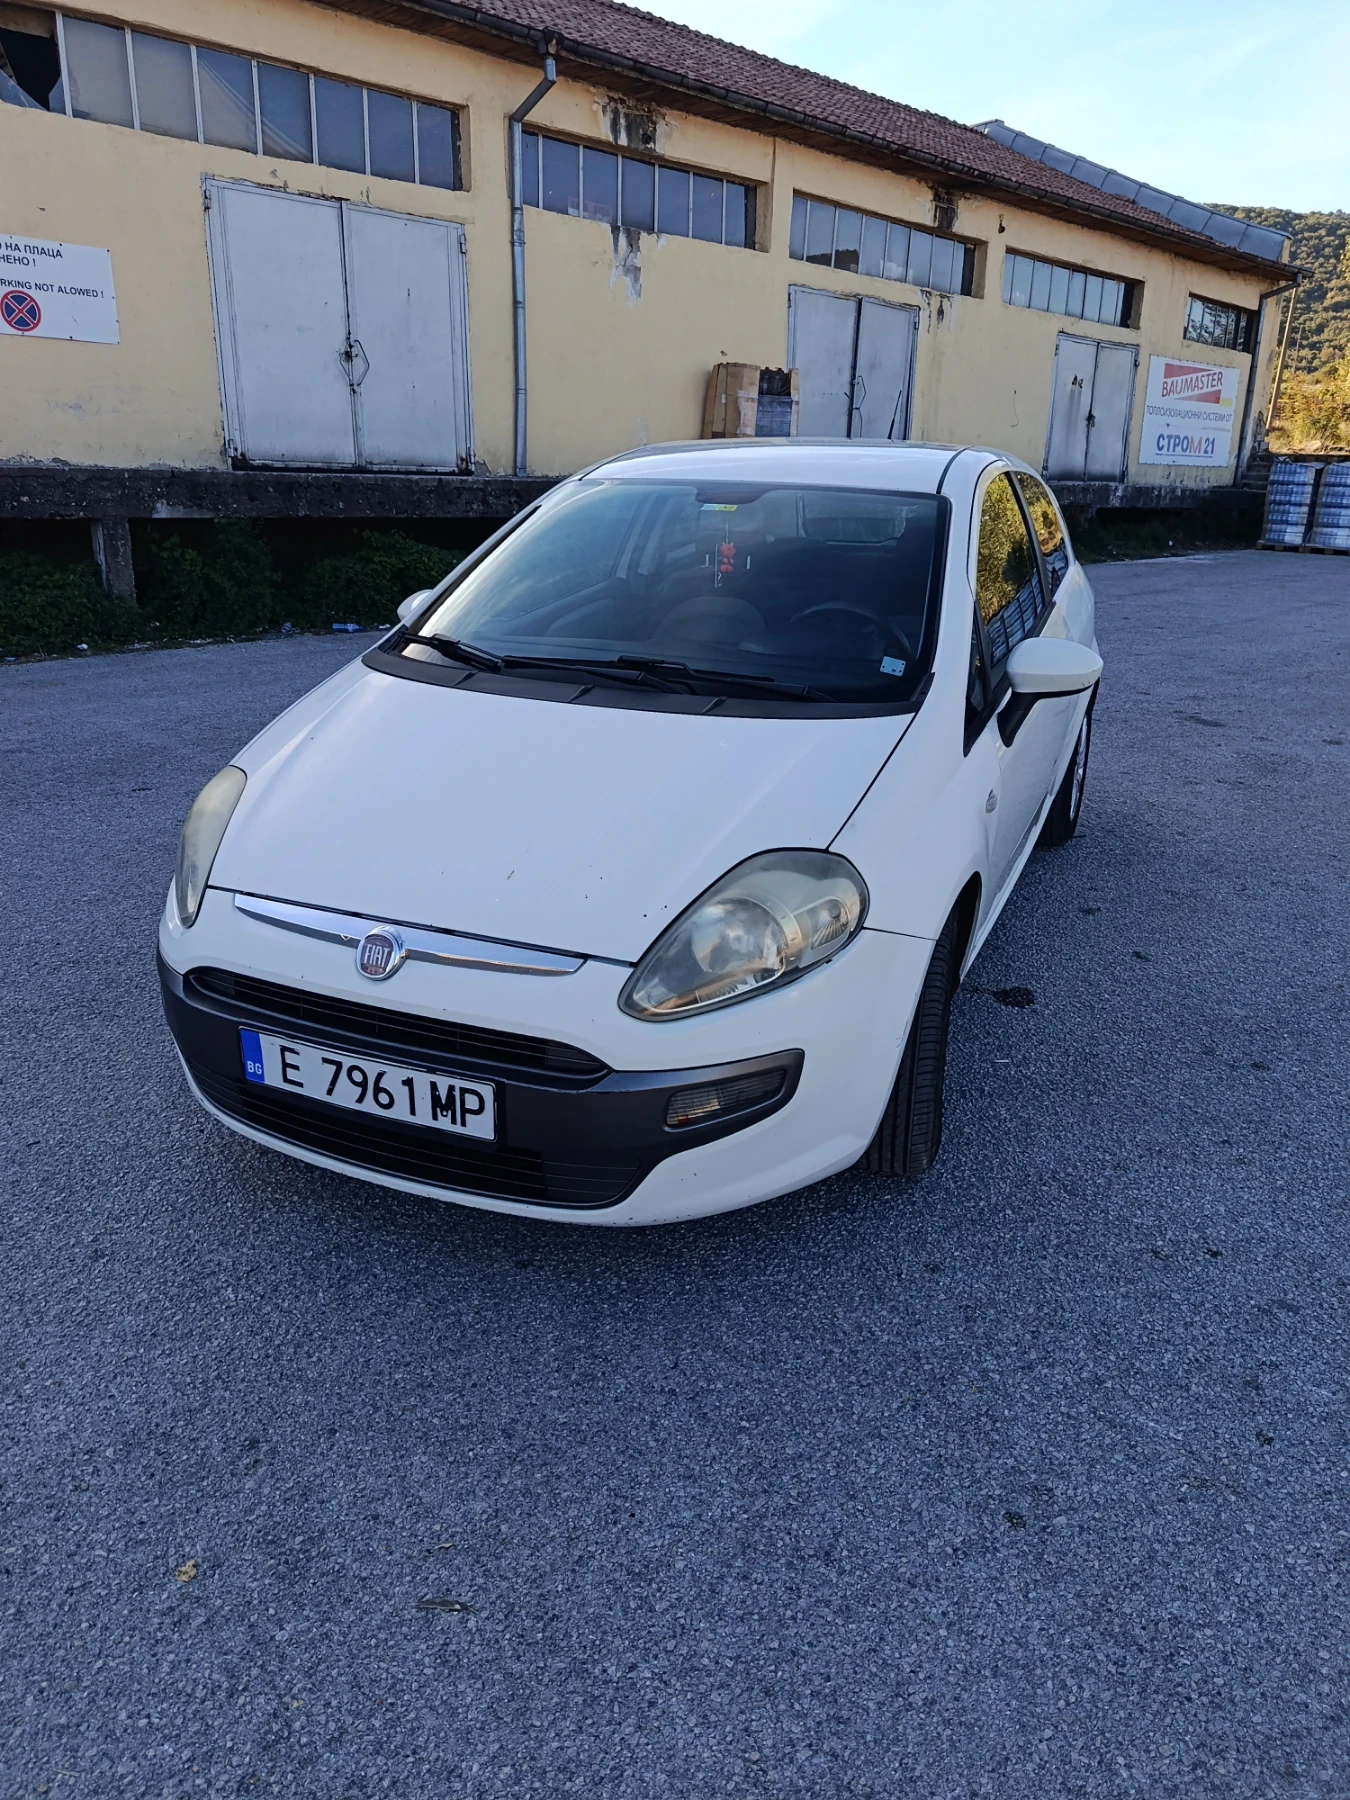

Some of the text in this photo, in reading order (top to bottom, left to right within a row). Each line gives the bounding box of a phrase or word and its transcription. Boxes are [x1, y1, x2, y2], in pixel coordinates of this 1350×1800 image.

[5, 242, 22, 252] НА
[24, 245, 63, 258] ПЛАЦА
[32, 258, 36, 267] !
[34, 282, 55, 293] NOT
[57, 286, 99, 298] ALOWED
[100, 290, 104, 299] !
[1162, 372, 1223, 397] BAUMASTER
[1156, 433, 1215, 455] СТРОМ 21
[363, 943, 391, 968] FIAT
[247, 1060, 263, 1075] BG
[279, 1044, 486, 1128] E 7961 MP
